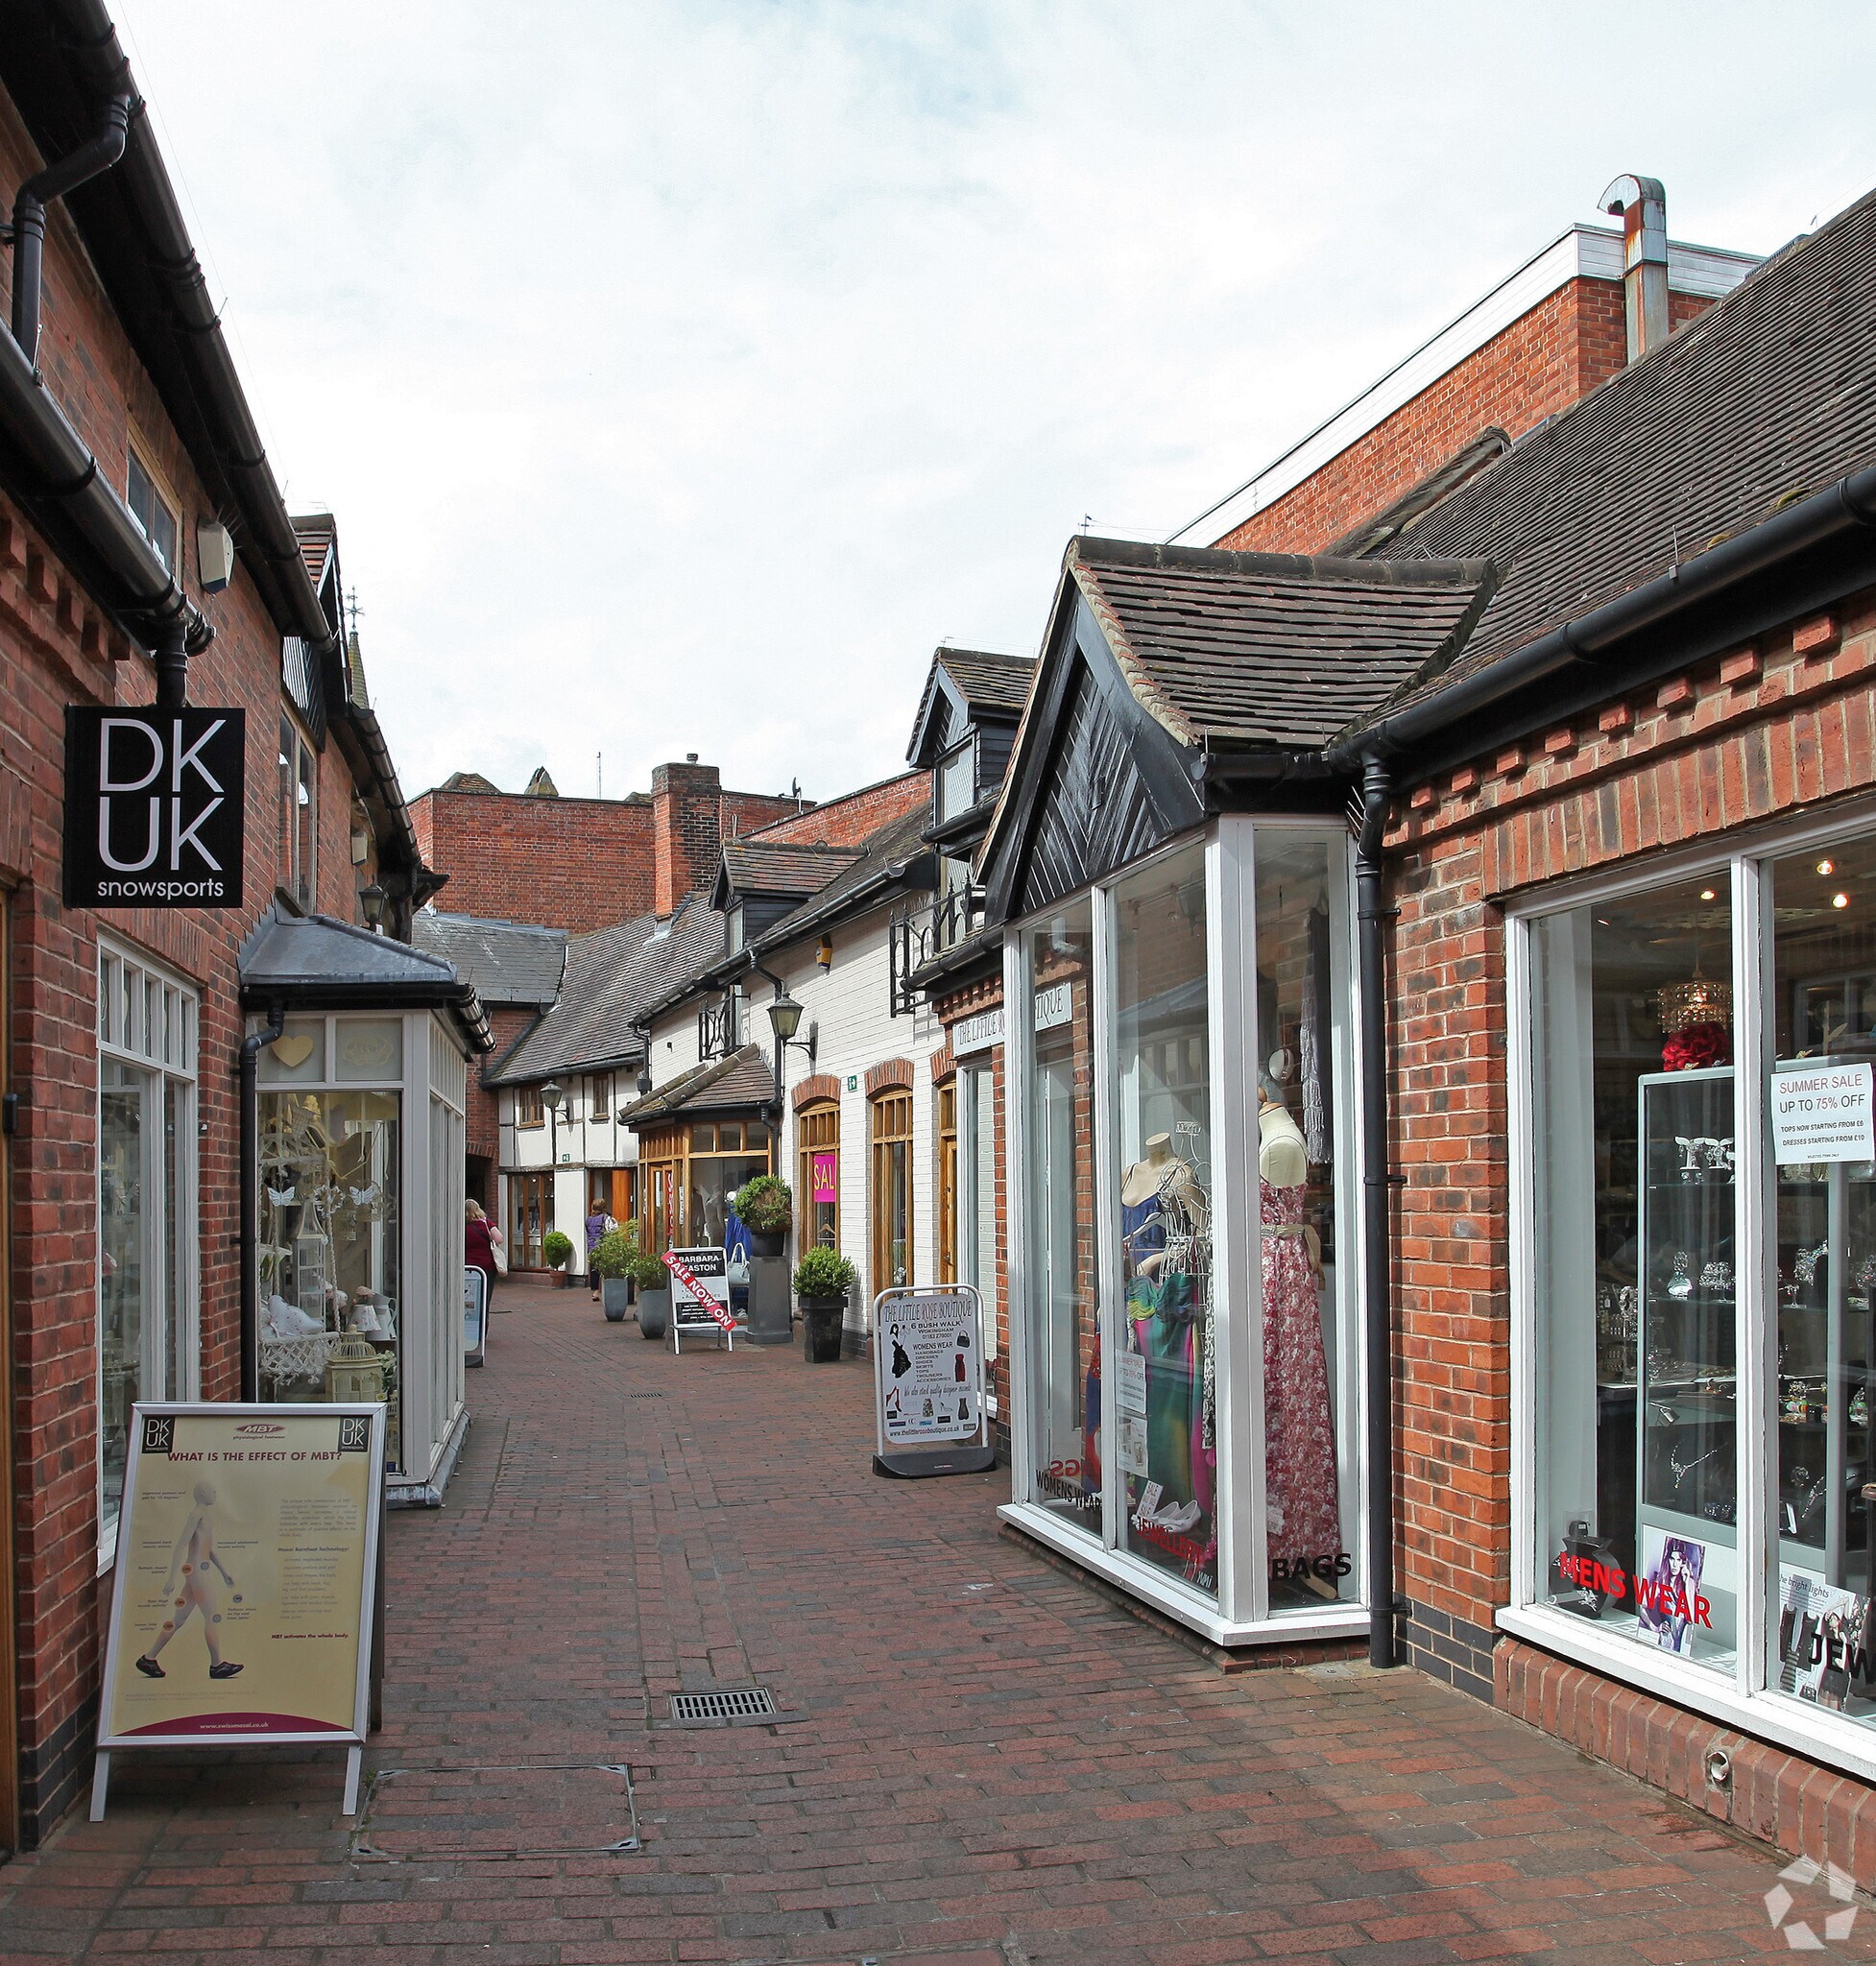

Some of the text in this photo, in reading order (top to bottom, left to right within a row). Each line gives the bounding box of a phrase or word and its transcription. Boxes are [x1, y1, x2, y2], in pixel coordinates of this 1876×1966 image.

[100, 718, 227, 792] DK
[99, 797, 225, 872] UK
[98, 878, 224, 900] snowsports
[1036, 988, 1063, 1024] TIQUE
[1780, 1074, 1863, 1094] SUMMER SALE
[1780, 1094, 1865, 1114] UP TO 75% OFF
[1783, 1138, 1807, 1146] DRESSES
[1808, 1136, 1834, 1144] STARTING
[813, 1163, 834, 1190] SAL
[665, 1256, 691, 1281] SALE
[688, 1280, 716, 1307] NOW
[713, 1307, 733, 1327] ON
[147, 1419, 171, 1433] DK
[244, 1425, 277, 1433] MBT
[343, 1418, 366, 1433] DK
[146, 1433, 170, 1447] UK
[342, 1432, 364, 1446] UK
[167, 1451, 342, 1462] WHAT IS THE EFFECT OF MBT?
[1036, 1469, 1072, 1503] WOMENS
[1272, 1552, 1352, 1582] BAGS
[1559, 1551, 1714, 1630] MENS WEAR
[1789, 1575, 1808, 1592] bright
[1809, 1582, 1830, 1599] lights
